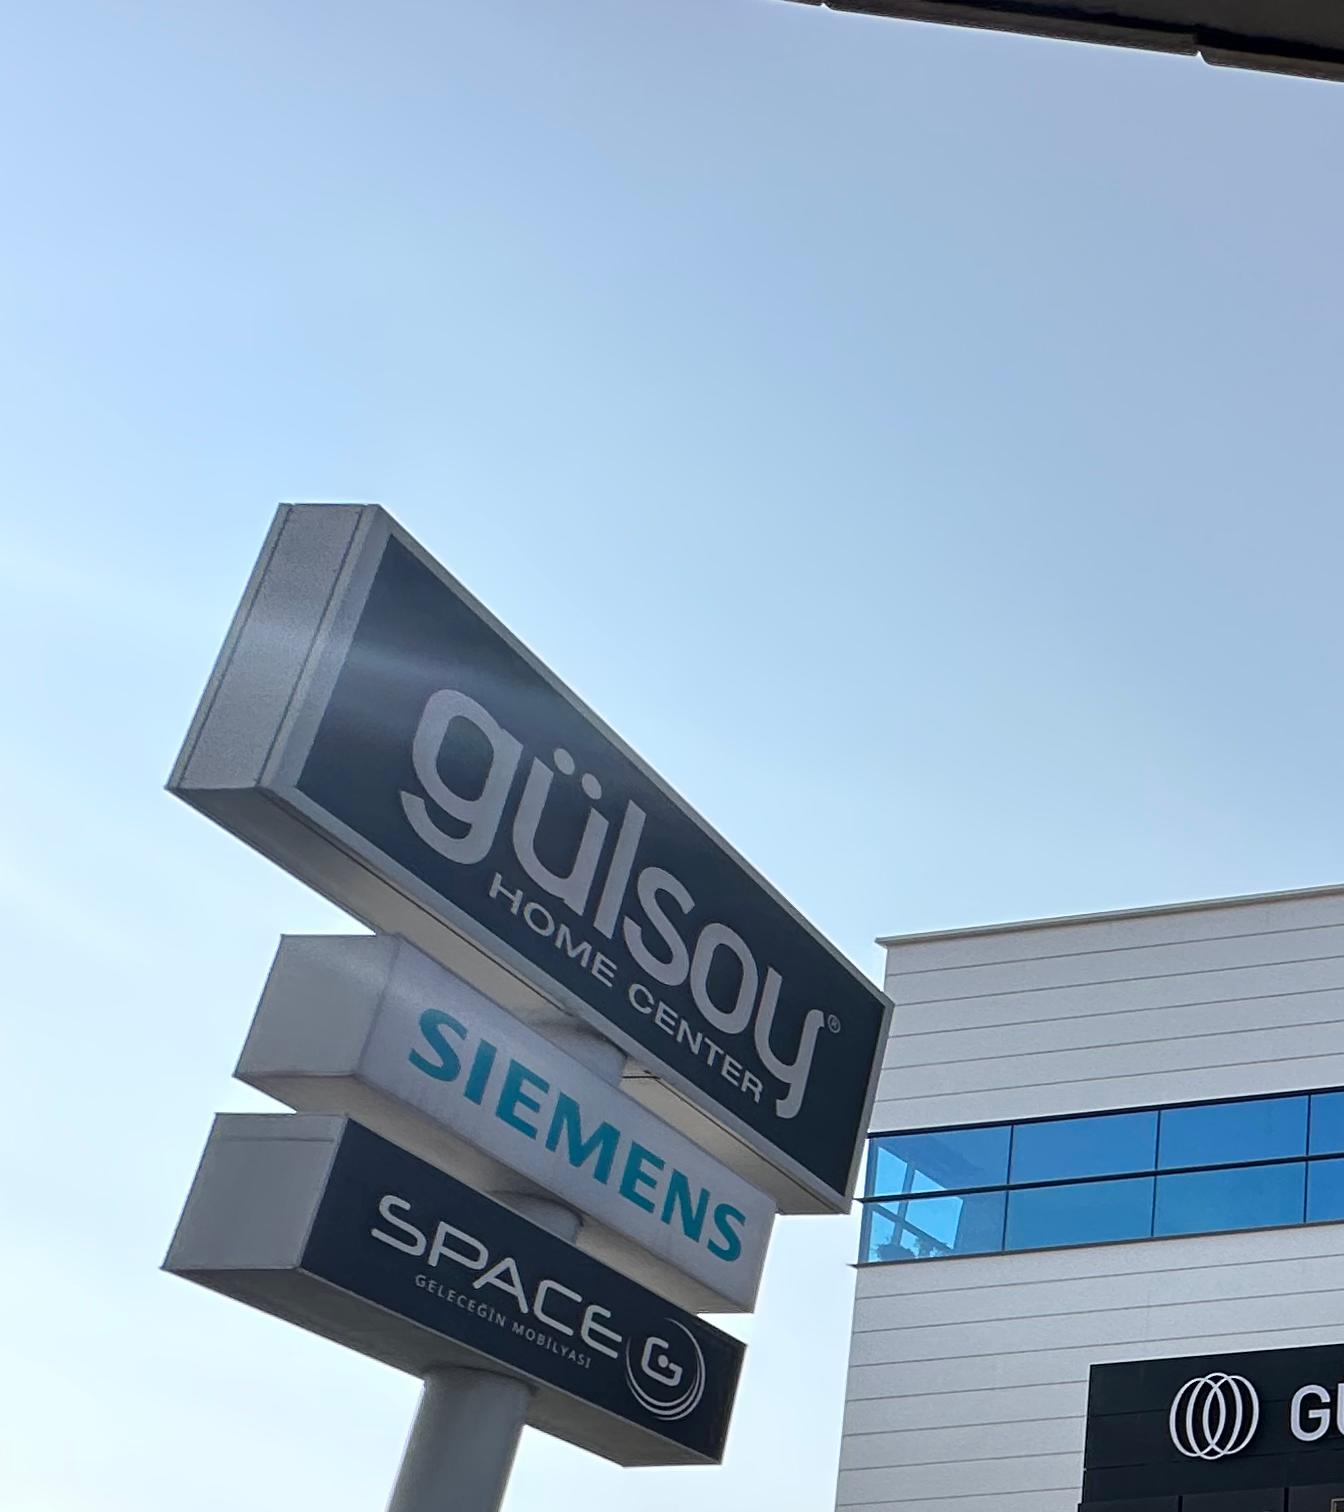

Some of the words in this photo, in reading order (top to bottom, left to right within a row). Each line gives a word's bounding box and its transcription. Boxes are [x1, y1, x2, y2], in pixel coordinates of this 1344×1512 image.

[401, 689, 824, 1119] gülsoy
[489, 873, 618, 988] HOME
[628, 983, 764, 1103] CENTER
[408, 1008, 746, 1262] SIEMENS
[371, 1195, 622, 1359] SPACE
[415, 1274, 505, 1328] GELECEĞİN
[512, 1321, 591, 1369] MOBİLYASI
